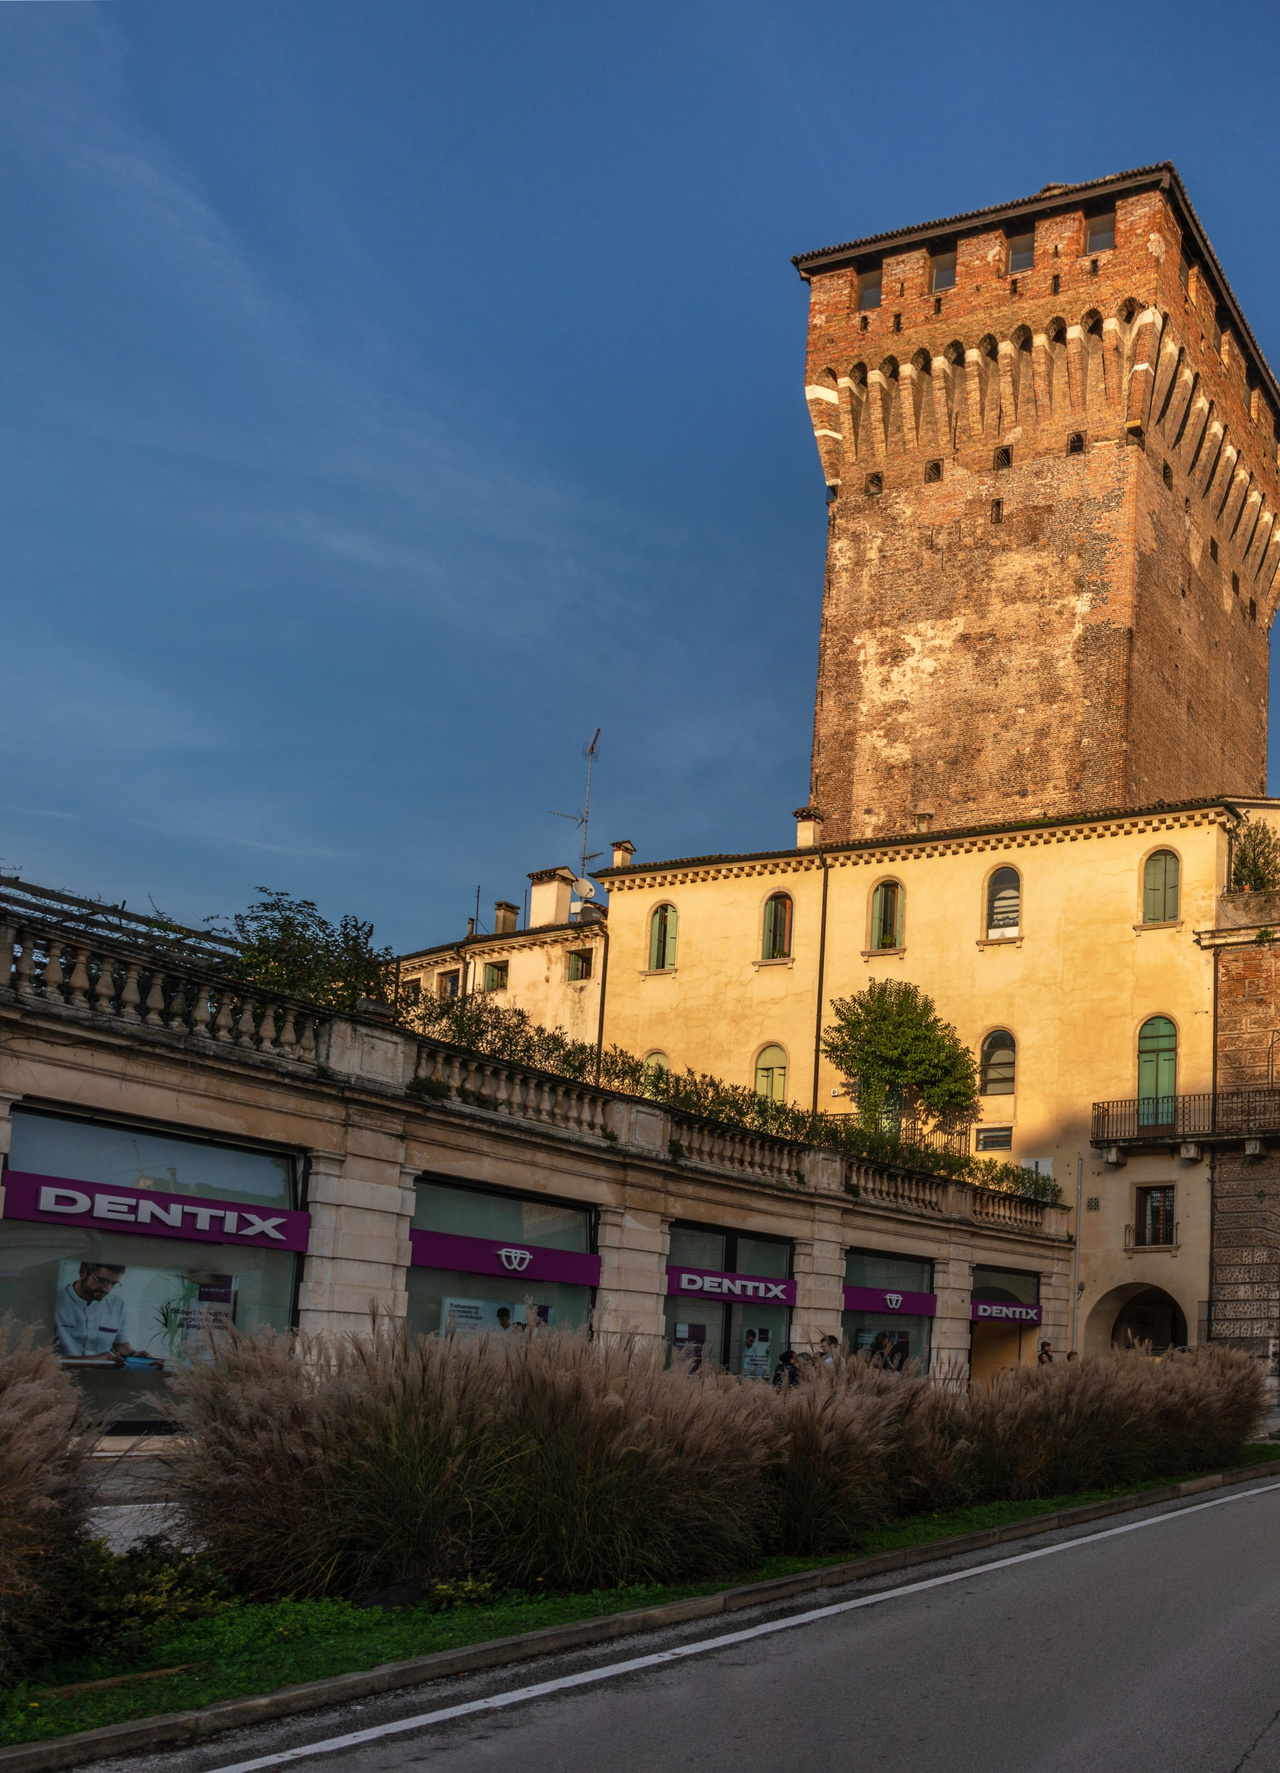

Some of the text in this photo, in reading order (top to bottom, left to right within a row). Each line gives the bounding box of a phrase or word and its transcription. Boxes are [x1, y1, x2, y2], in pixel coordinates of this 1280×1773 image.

[39, 1185, 288, 1240] DENTIX
[680, 1273, 787, 1299] DENTIX
[171, 1307, 196, 1316] Scopri
[977, 1304, 1038, 1320] DENTIX
